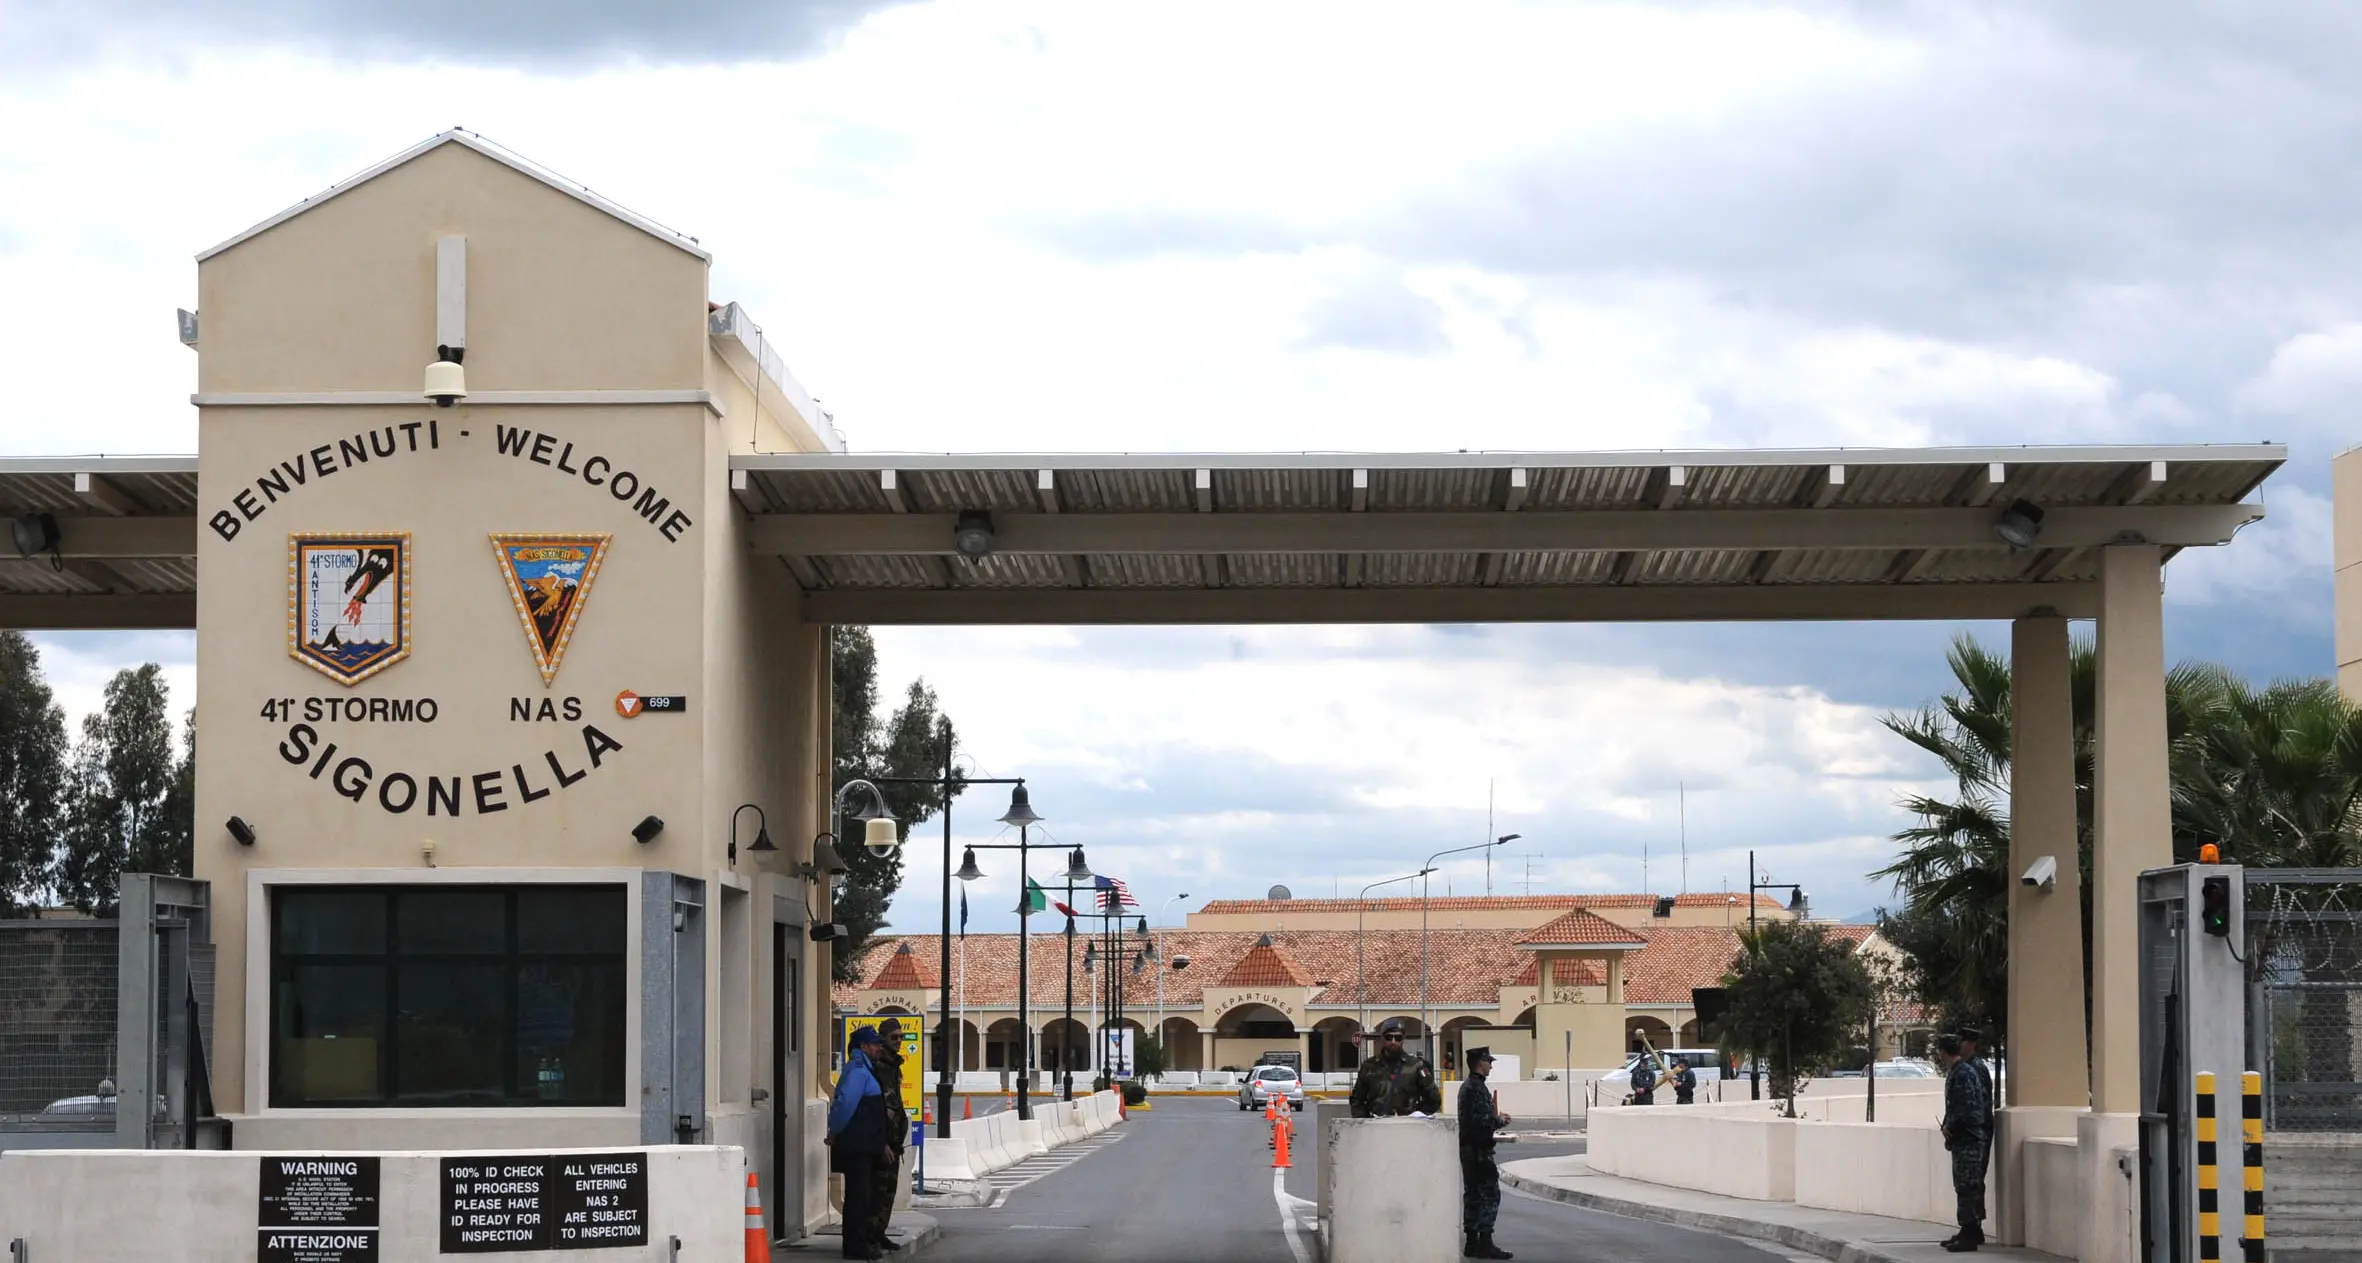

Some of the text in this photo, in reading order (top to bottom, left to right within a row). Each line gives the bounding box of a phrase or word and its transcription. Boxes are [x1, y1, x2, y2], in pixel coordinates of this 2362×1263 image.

[209, 420, 439, 542] BENVENUTI
[496, 424, 692, 543] WELCOME
[324, 554, 357, 569] STORMO
[311, 571, 319, 636] ANTISOM
[510, 696, 583, 722] NAS
[649, 697, 670, 707] 699
[303, 697, 438, 723] STORMO
[279, 723, 623, 817] SIGONELLA
[866, 995, 921, 1014] ESTAURAN
[1214, 993, 1294, 1015] DEPARTURES
[281, 1162, 358, 1175] WARNING
[449, 1166, 544, 1178] 100% ID CHECK
[564, 1163, 638, 1176] ALL VEHICLES
[455, 1182, 540, 1194] IN PROGRESS
[575, 1179, 627, 1191] ENTERING
[455, 1198, 539, 1210] PLEASE HAVE
[586, 1196, 619, 1207] NAS 2
[451, 1214, 541, 1226] ID READY FOR
[564, 1209, 637, 1223] ARE SUBJECT
[462, 1230, 533, 1242] INSPECTION
[561, 1225, 641, 1239] TO INSPECTION
[267, 1235, 369, 1249] ATTENZIONE
